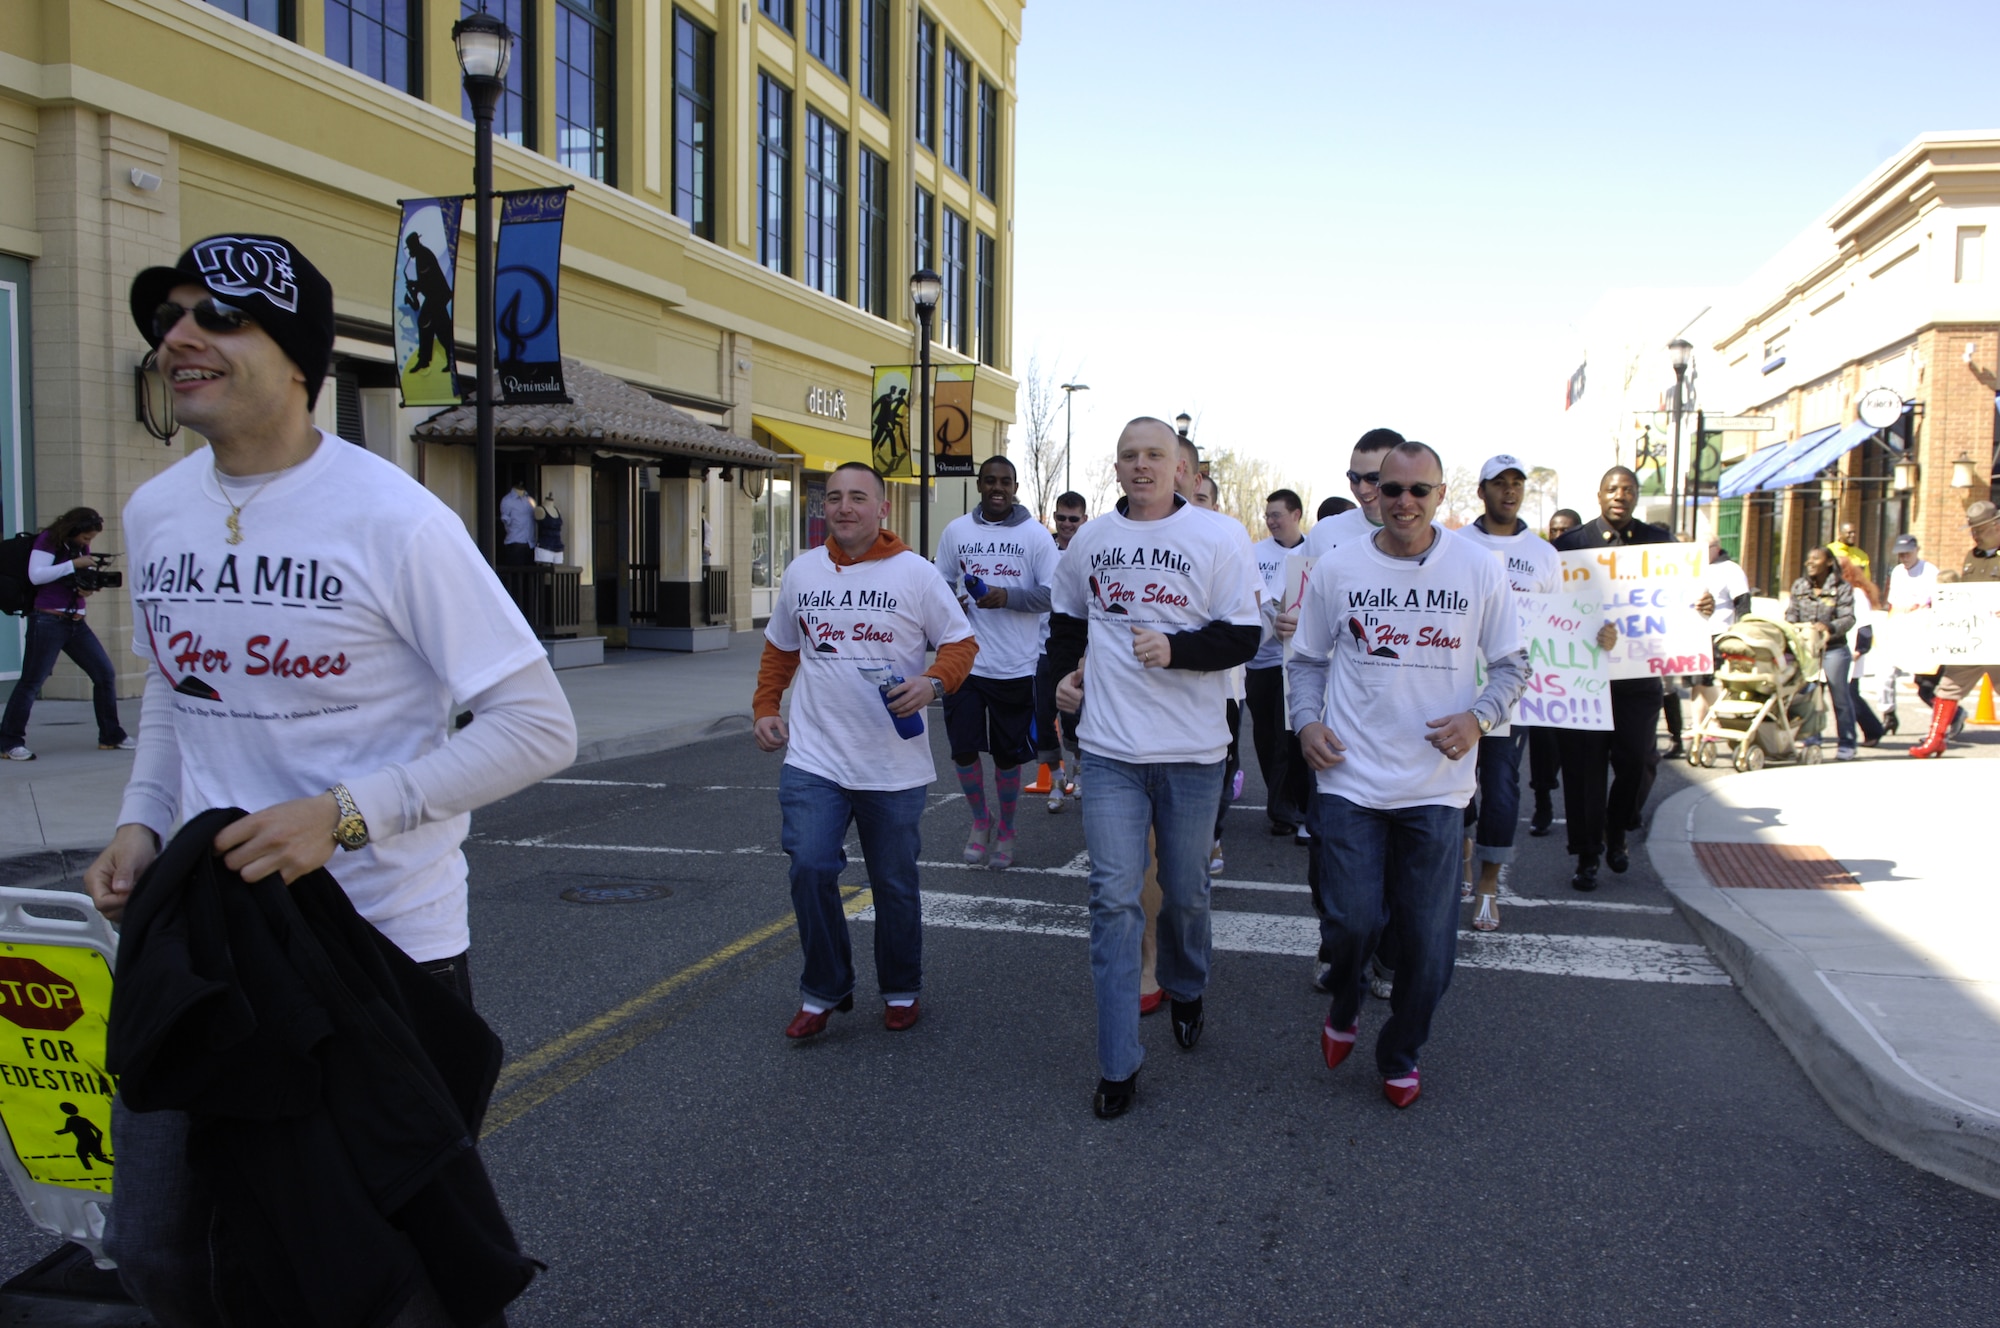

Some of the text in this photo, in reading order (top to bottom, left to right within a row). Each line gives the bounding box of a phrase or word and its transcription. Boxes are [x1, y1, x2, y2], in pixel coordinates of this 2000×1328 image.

[504, 375, 561, 393] Peninsula
[936, 461, 972, 471] Peninsula
[957, 542, 1025, 556] Walk A Mile
[1091, 547, 1192, 573] Walk A Mile
[965, 557, 973, 565] In
[971, 563, 1022, 577] Her Shoes
[1259, 561, 1280, 571] Wal
[1508, 557, 1534, 573] Mile
[1561, 560, 1591, 583] in
[1655, 554, 1679, 577] in
[141, 552, 344, 602] Walk A Mile
[1100, 571, 1111, 584] In
[798, 590, 897, 610] Walk A Mile
[1107, 581, 1190, 608] Her Shoes
[1348, 588, 1469, 612] Walk A Mile
[152, 604, 171, 633] In
[807, 612, 818, 625] In
[1364, 613, 1379, 626] In
[1548, 614, 1582, 635] NO!
[816, 622, 895, 643] Her Shoes
[1375, 624, 1462, 650] Her Shoes
[168, 630, 352, 679] Her Shoes
[1526, 637, 1602, 671] ALLY
[1646, 653, 1712, 676] RAPED
[1519, 697, 1603, 725] NO!!!
[0, 979, 75, 1009] TOP
[22, 1036, 79, 1063] FOR
[0, 1064, 119, 1097] EDESTRIA
